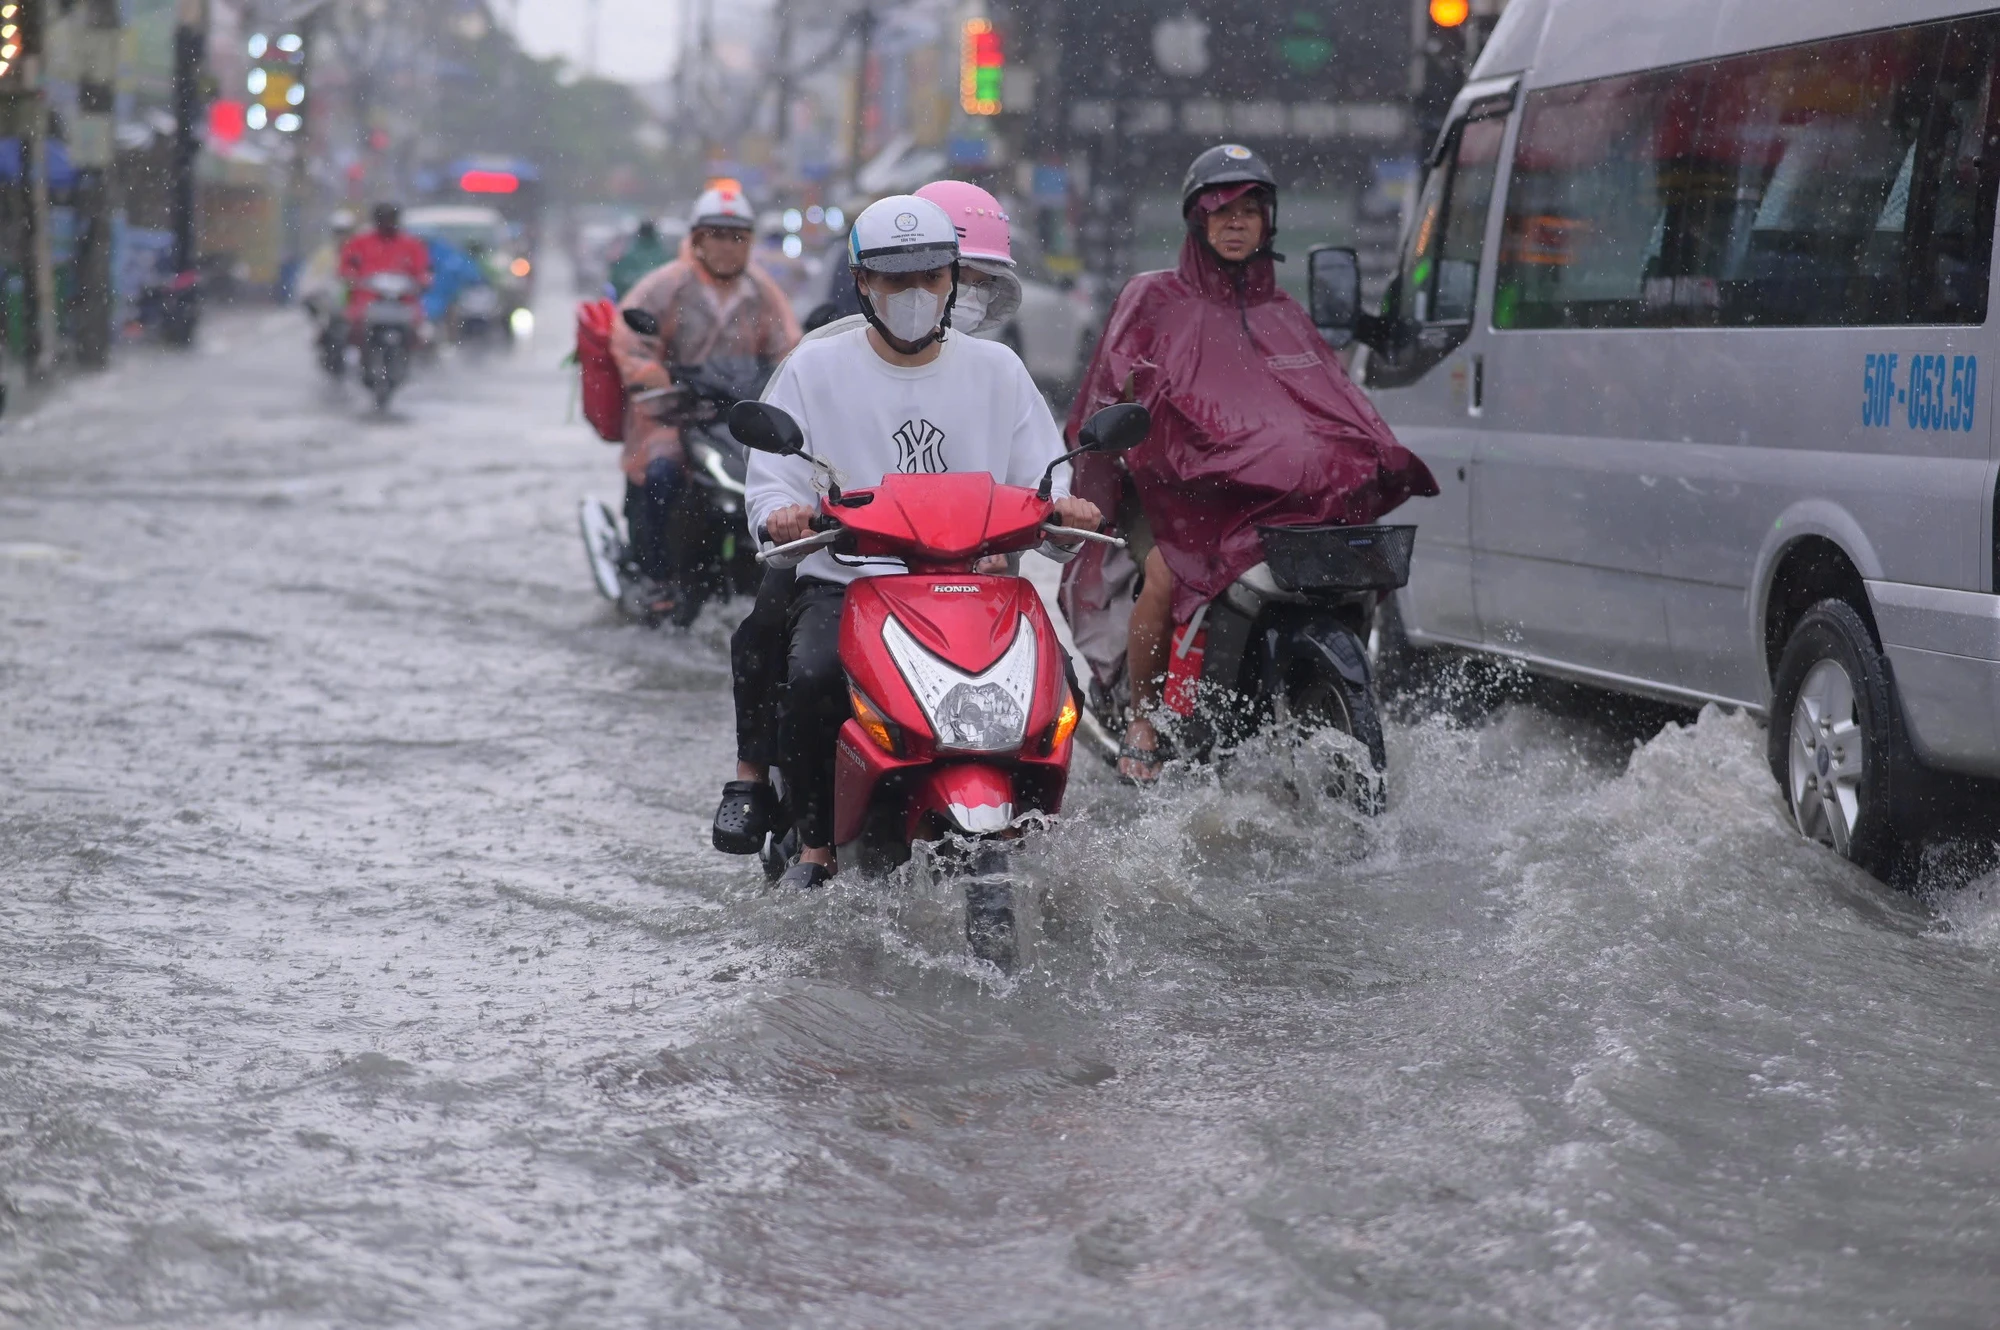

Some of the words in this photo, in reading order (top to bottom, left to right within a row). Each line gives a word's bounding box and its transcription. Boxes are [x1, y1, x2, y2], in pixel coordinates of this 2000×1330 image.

[1862, 353, 1977, 433] 50F-053.59
[934, 585, 979, 593] HONDA
[839, 739, 867, 772] HONDA
